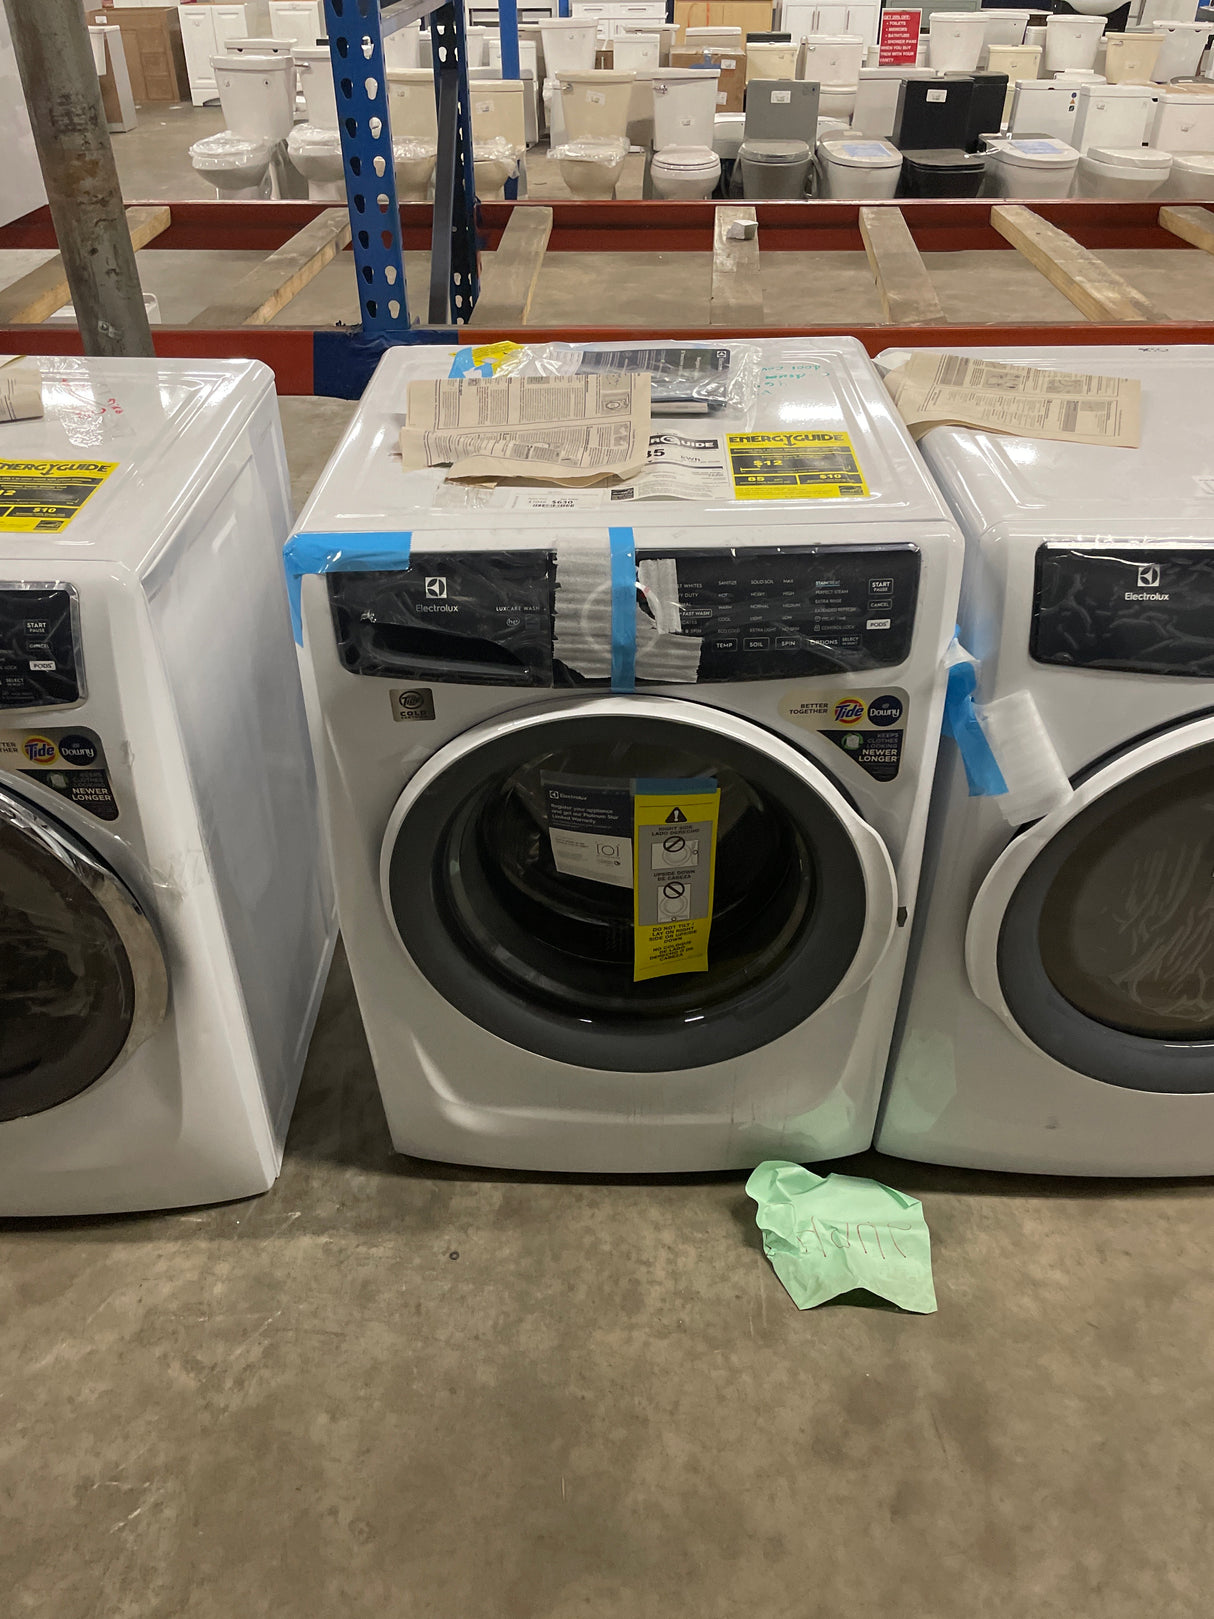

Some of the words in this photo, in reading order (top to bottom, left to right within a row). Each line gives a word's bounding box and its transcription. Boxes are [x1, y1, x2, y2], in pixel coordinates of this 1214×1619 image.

[1124, 591, 1170, 601] Electrolux
[416, 604, 459, 612] Electrolux
[834, 704, 864, 721] Tide
[870, 708, 900, 718] Downy
[24, 742, 54, 761] Tide
[62, 747, 94, 757] Downy
[572, 816, 596, 824] Warranty
